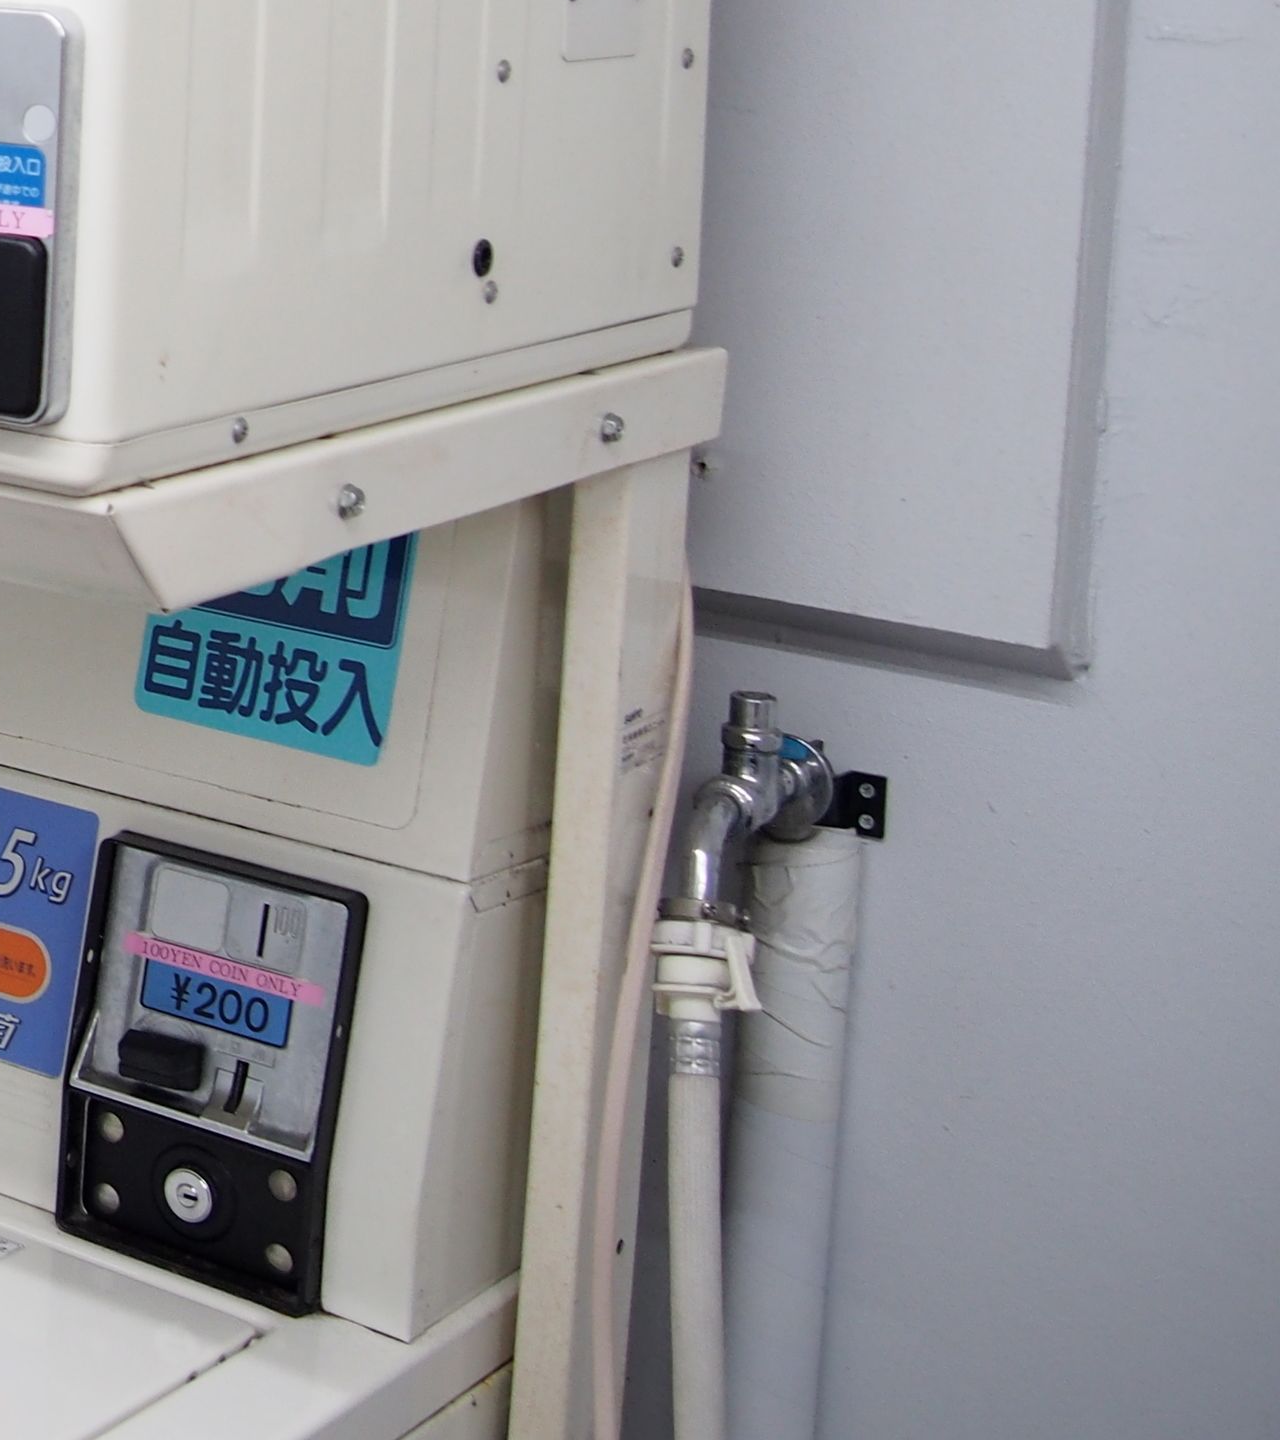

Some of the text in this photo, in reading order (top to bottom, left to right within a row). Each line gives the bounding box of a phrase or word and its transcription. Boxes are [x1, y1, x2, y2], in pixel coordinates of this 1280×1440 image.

[143, 619, 383, 748] 自動投入
[140, 940, 303, 998] 100YEN COIN ONLY
[170, 972, 271, 1034] ¥200
